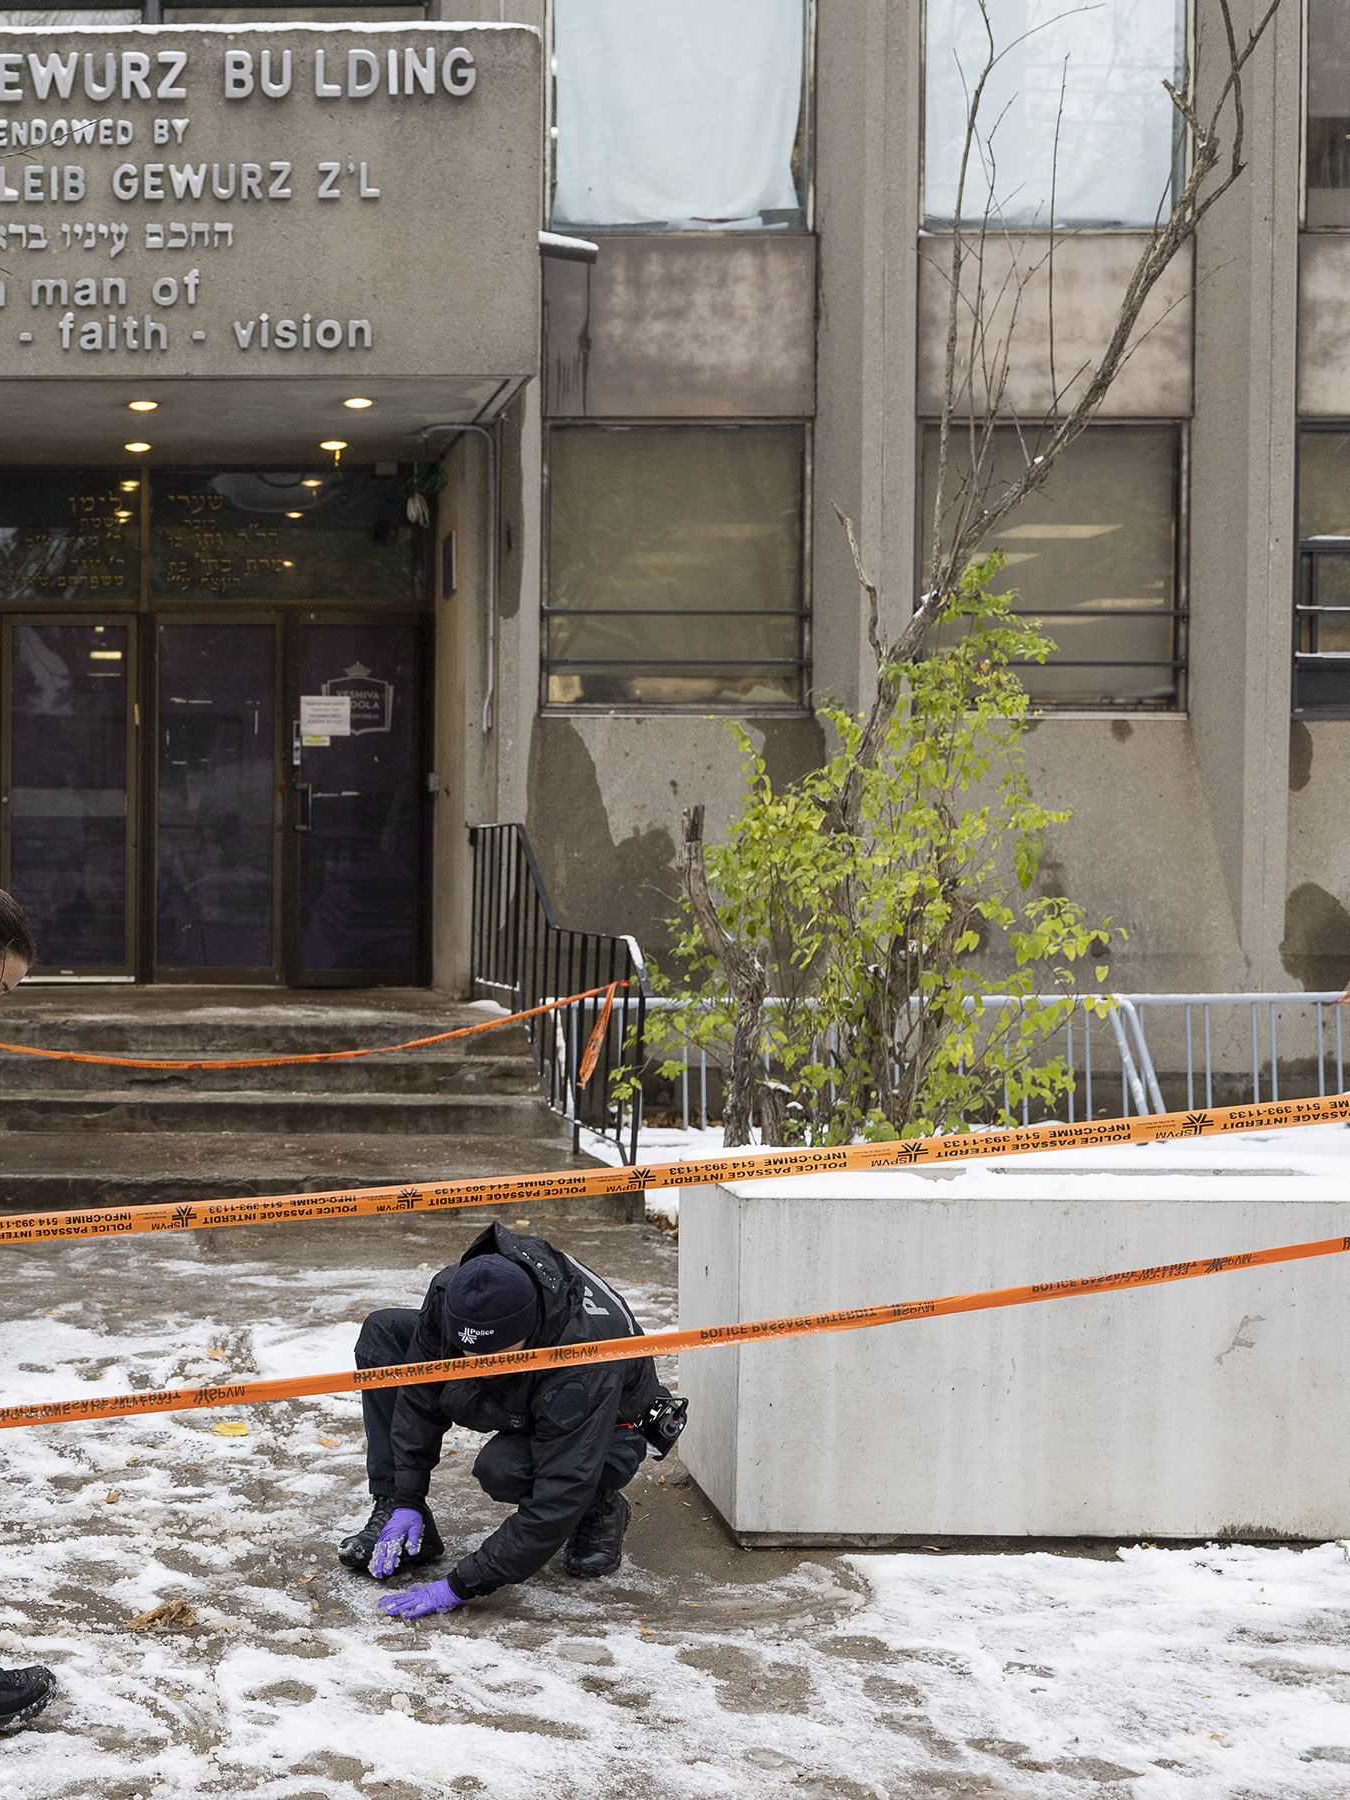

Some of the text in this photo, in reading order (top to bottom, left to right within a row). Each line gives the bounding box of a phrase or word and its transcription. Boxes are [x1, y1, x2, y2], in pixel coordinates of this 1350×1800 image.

[153, 118, 190, 145] BY
[0, 164, 86, 201] LEIB
[112, 162, 292, 199] GEWURZ
[317, 161, 381, 199] Z'L
[61, 222, 129, 258] עיניו
[145, 222, 234, 249] החכם
[31, 277, 127, 307] man
[152, 268, 200, 306] of
[19, 331, 33, 343] -
[58, 312, 168, 350] faith
[192, 330, 206, 341] -
[233, 312, 373, 349] vision
[351, 700, 380, 710] DOLA
[1230, 1105, 1291, 1120] 393-1133
[1297, 1103, 1320, 1113] 514
[1049, 1122, 1130, 1138] INFO-CRIME
[1221, 1116, 1287, 1131] INTERDIT
[1016, 1131, 1039, 1142] 514
[1156, 1123, 1194, 1140] SPVM
[934, 1132, 1130, 1158] POLICE PASSAGE INTERDIT
[944, 1135, 1009, 1149] 393-1133
[732, 1160, 754, 1169] 514
[765, 1150, 846, 1167] INFO-CRIME
[871, 1153, 908, 1168] SPVM
[662, 1160, 846, 1185] POLICE PASSAGE INTERDIT
[670, 1162, 727, 1175] 393-1133
[544, 1185, 586, 1196] POLICE
[606, 1178, 638, 1194] SPVM
[429, 1194, 482, 1207] INTERDIT
[487, 1189, 540, 1201] PASSAGE
[376, 1198, 407, 1212] SPVM
[66, 1211, 131, 1225] INFO-CRIME
[203, 1204, 358, 1224] POLICE PASSAGE INTERDIT
[39, 1217, 57, 1227] 514
[91, 1222, 131, 1233] POLICE
[152, 1216, 181, 1231] SPVM
[36, 1225, 87, 1237] PASSAGE
[469, 1327, 495, 1336] Police
